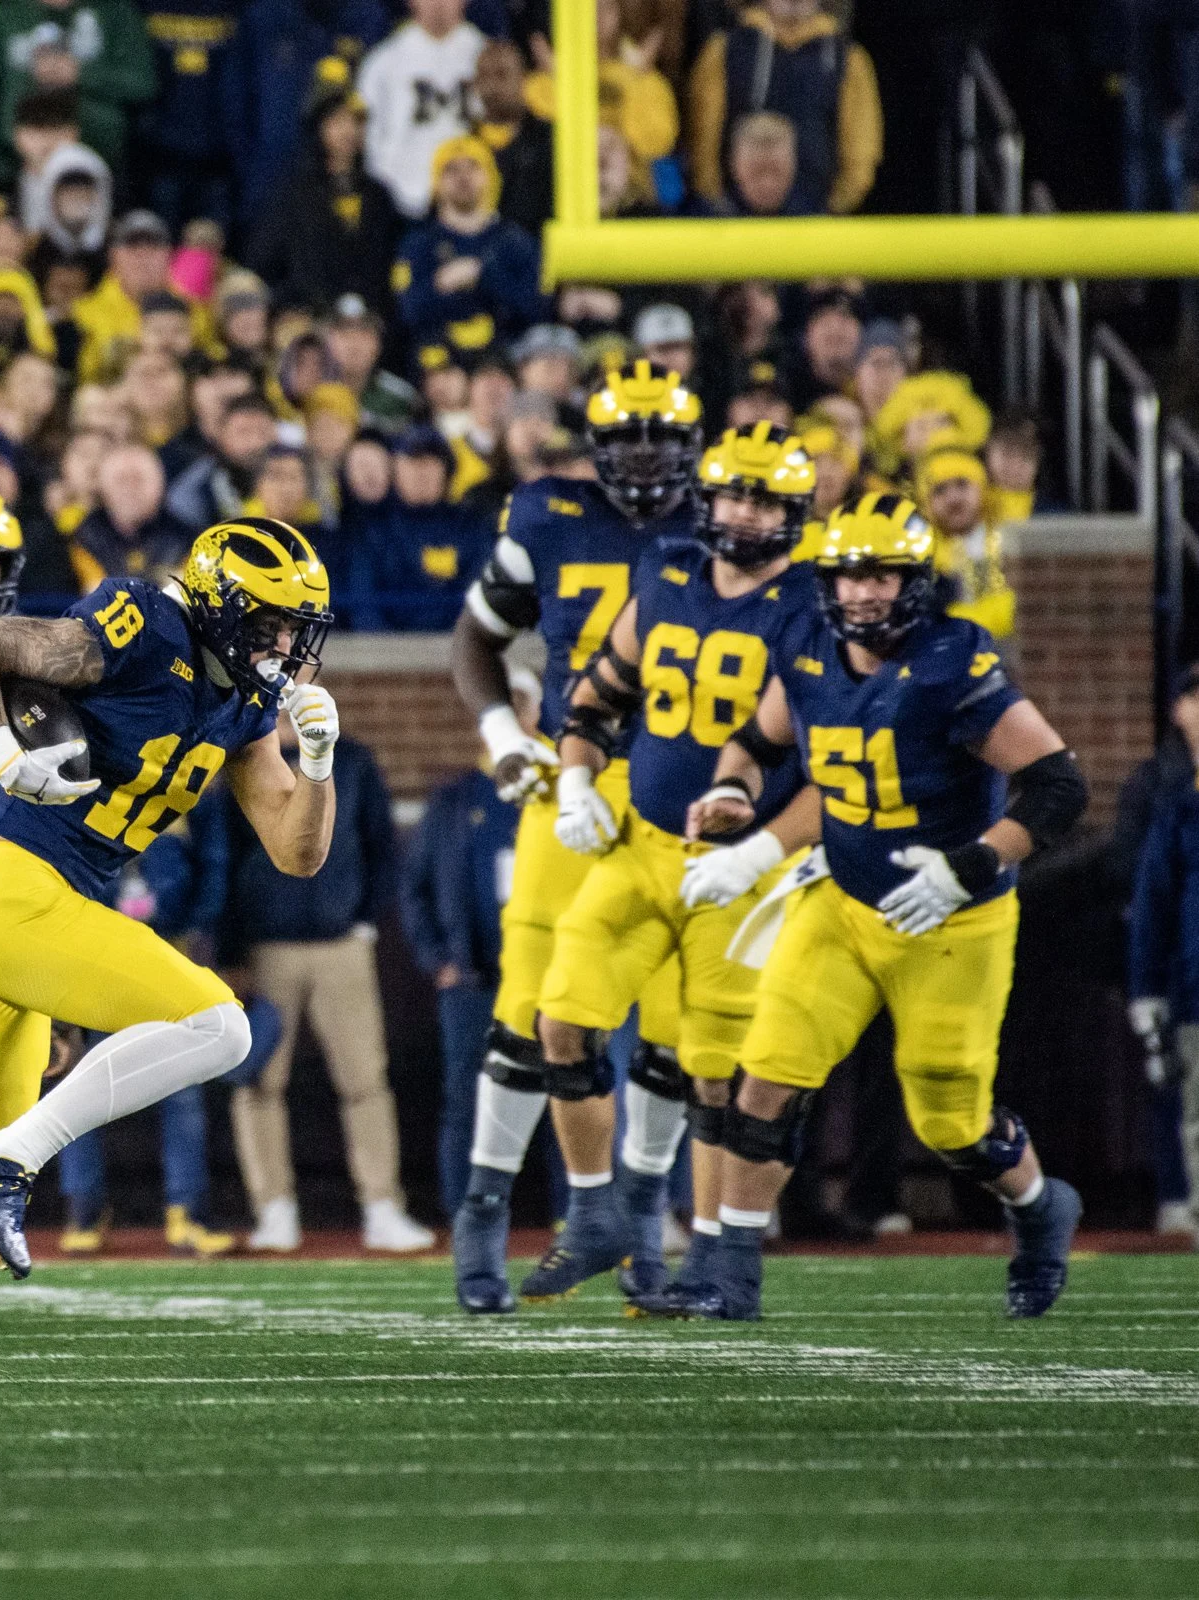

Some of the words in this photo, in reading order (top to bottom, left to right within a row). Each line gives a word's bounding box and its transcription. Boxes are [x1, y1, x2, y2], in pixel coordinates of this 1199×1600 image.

[411, 78, 473, 124] M
[94, 590, 145, 649] 18
[641, 621, 769, 747] 68
[83, 733, 226, 852] 18
[809, 725, 920, 830] 51
